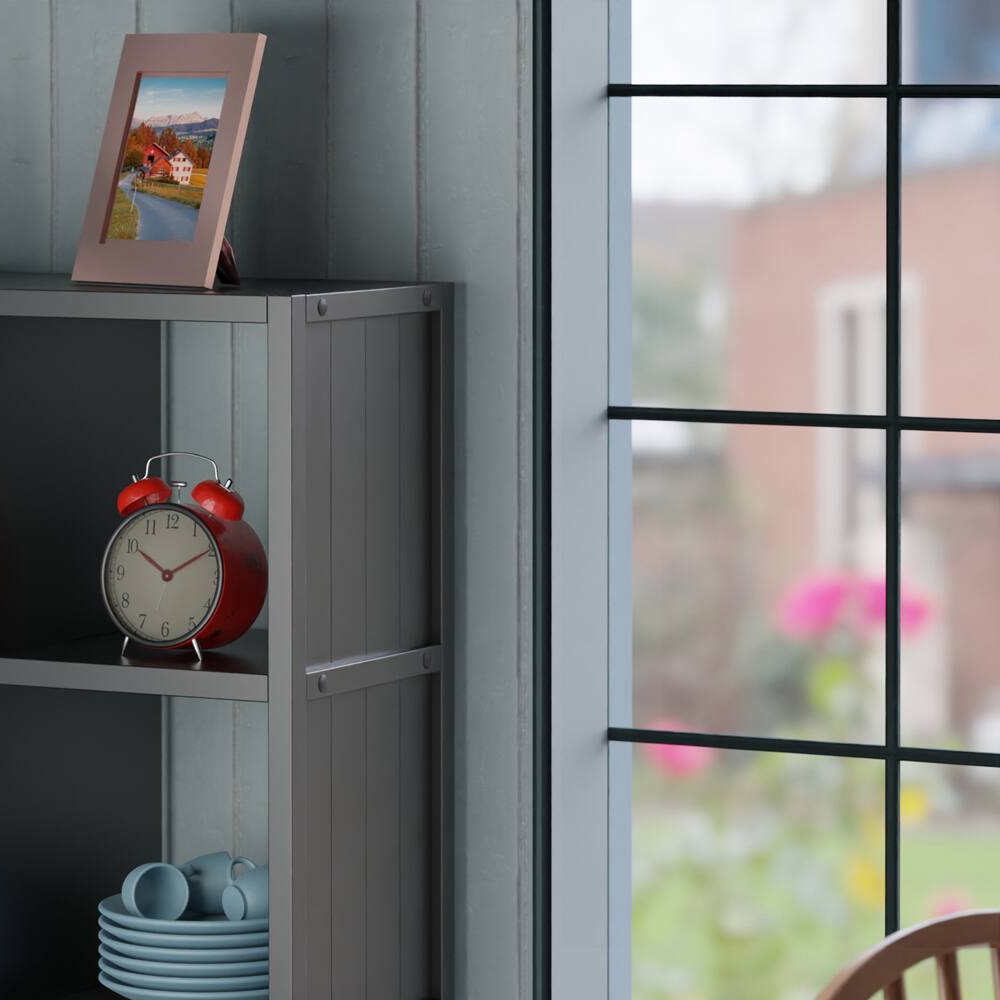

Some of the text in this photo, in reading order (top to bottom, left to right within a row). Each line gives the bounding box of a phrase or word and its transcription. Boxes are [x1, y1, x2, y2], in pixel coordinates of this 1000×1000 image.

[145, 520, 156, 535] 11
[166, 514, 179, 529] 12
[193, 521, 197, 537] 1
[127, 539, 138, 554] 10
[117, 565, 125, 580] 9
[121, 592, 129, 608] 8
[139, 614, 147, 629] 7
[161, 621, 170, 637] 6
[188, 616, 197, 632] 5
